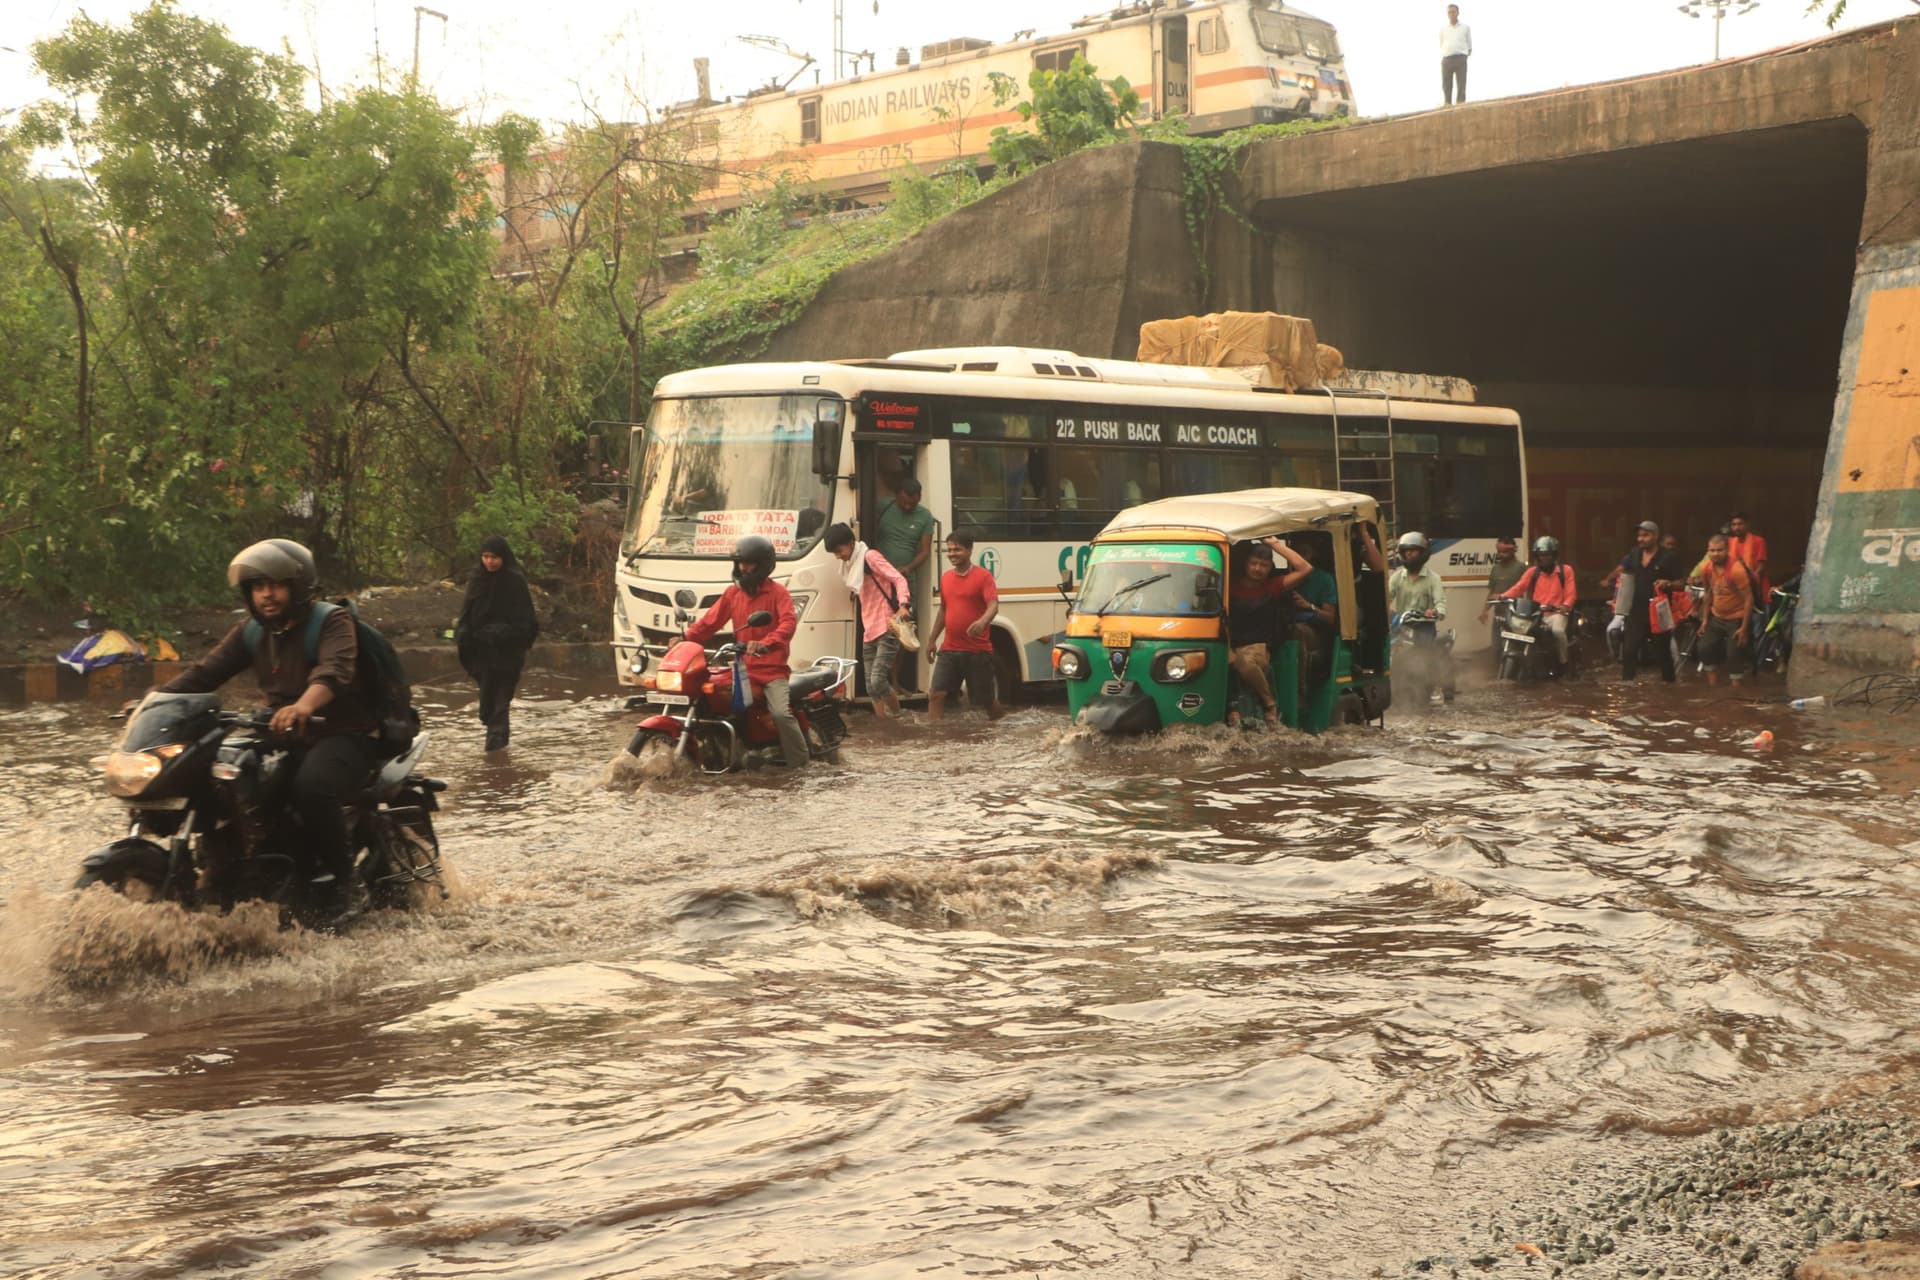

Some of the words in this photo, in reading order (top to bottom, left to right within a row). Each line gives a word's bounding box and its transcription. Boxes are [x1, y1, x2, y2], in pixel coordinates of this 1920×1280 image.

[825, 95, 879, 127] INDIAN
[886, 76, 971, 114] RAILWAYS
[1056, 419, 1075, 438] 2/2
[1084, 420, 1118, 440] PUSH
[1128, 422, 1161, 442] BACK
[1177, 425, 1200, 443] A/C
[1208, 426, 1257, 445] COACH
[754, 511, 795, 523] TATA
